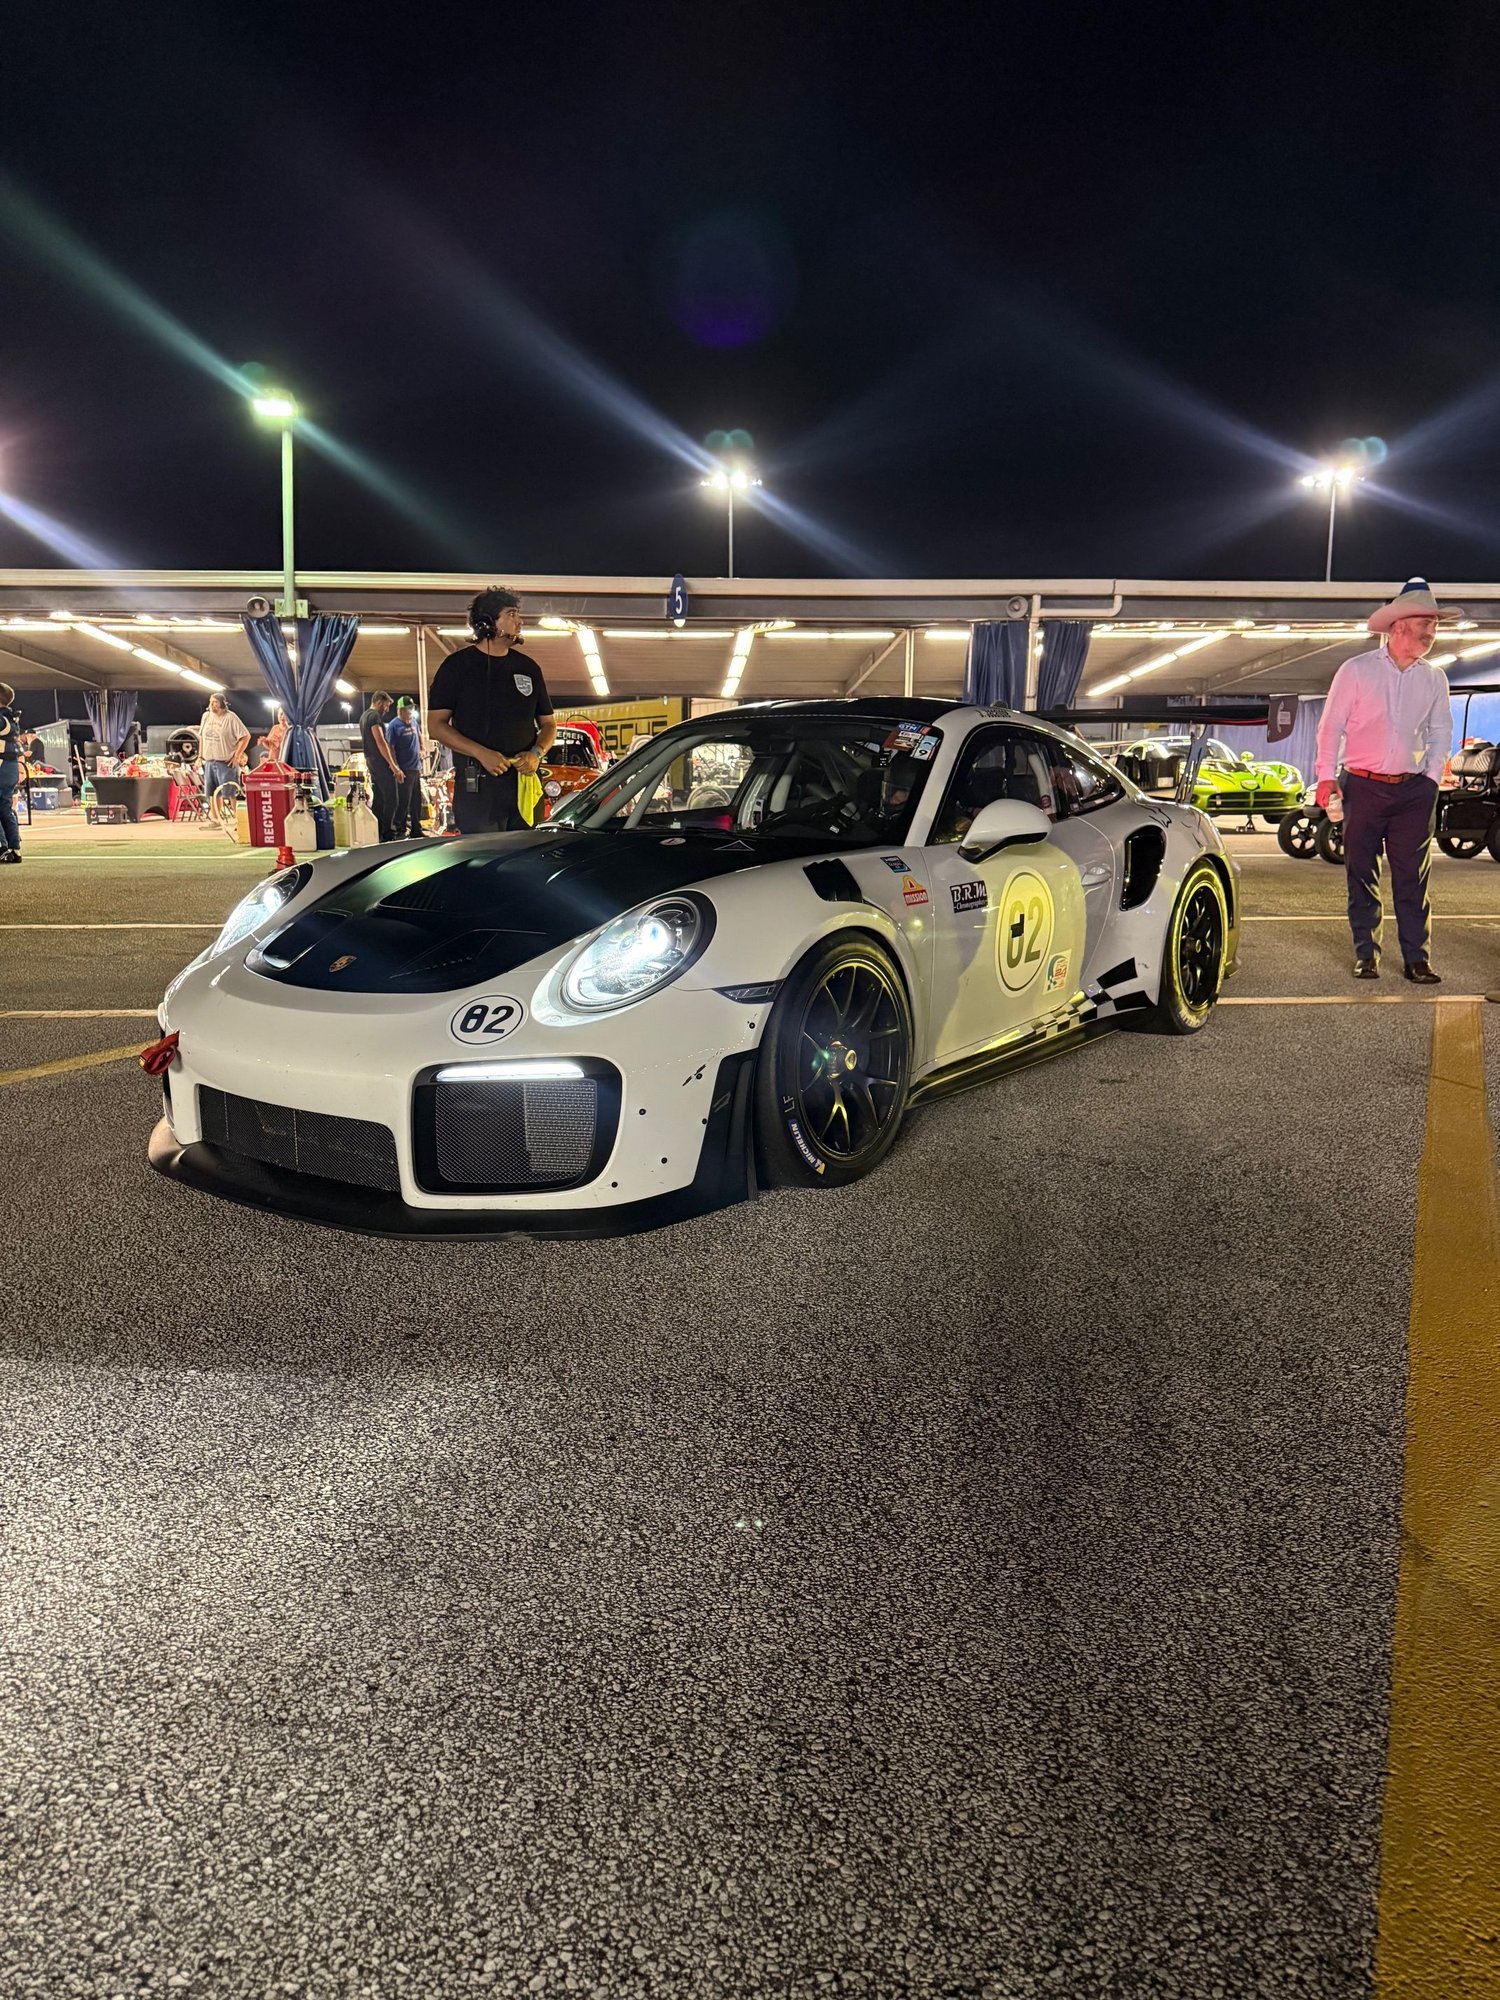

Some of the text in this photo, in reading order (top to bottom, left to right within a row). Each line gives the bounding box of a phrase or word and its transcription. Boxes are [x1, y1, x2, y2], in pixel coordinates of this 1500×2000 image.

[675, 586, 683, 614] 5
[261, 790, 275, 844] RECYCLE
[460, 1004, 515, 1034] 82
[792, 1123, 816, 1164] MICHELIN
